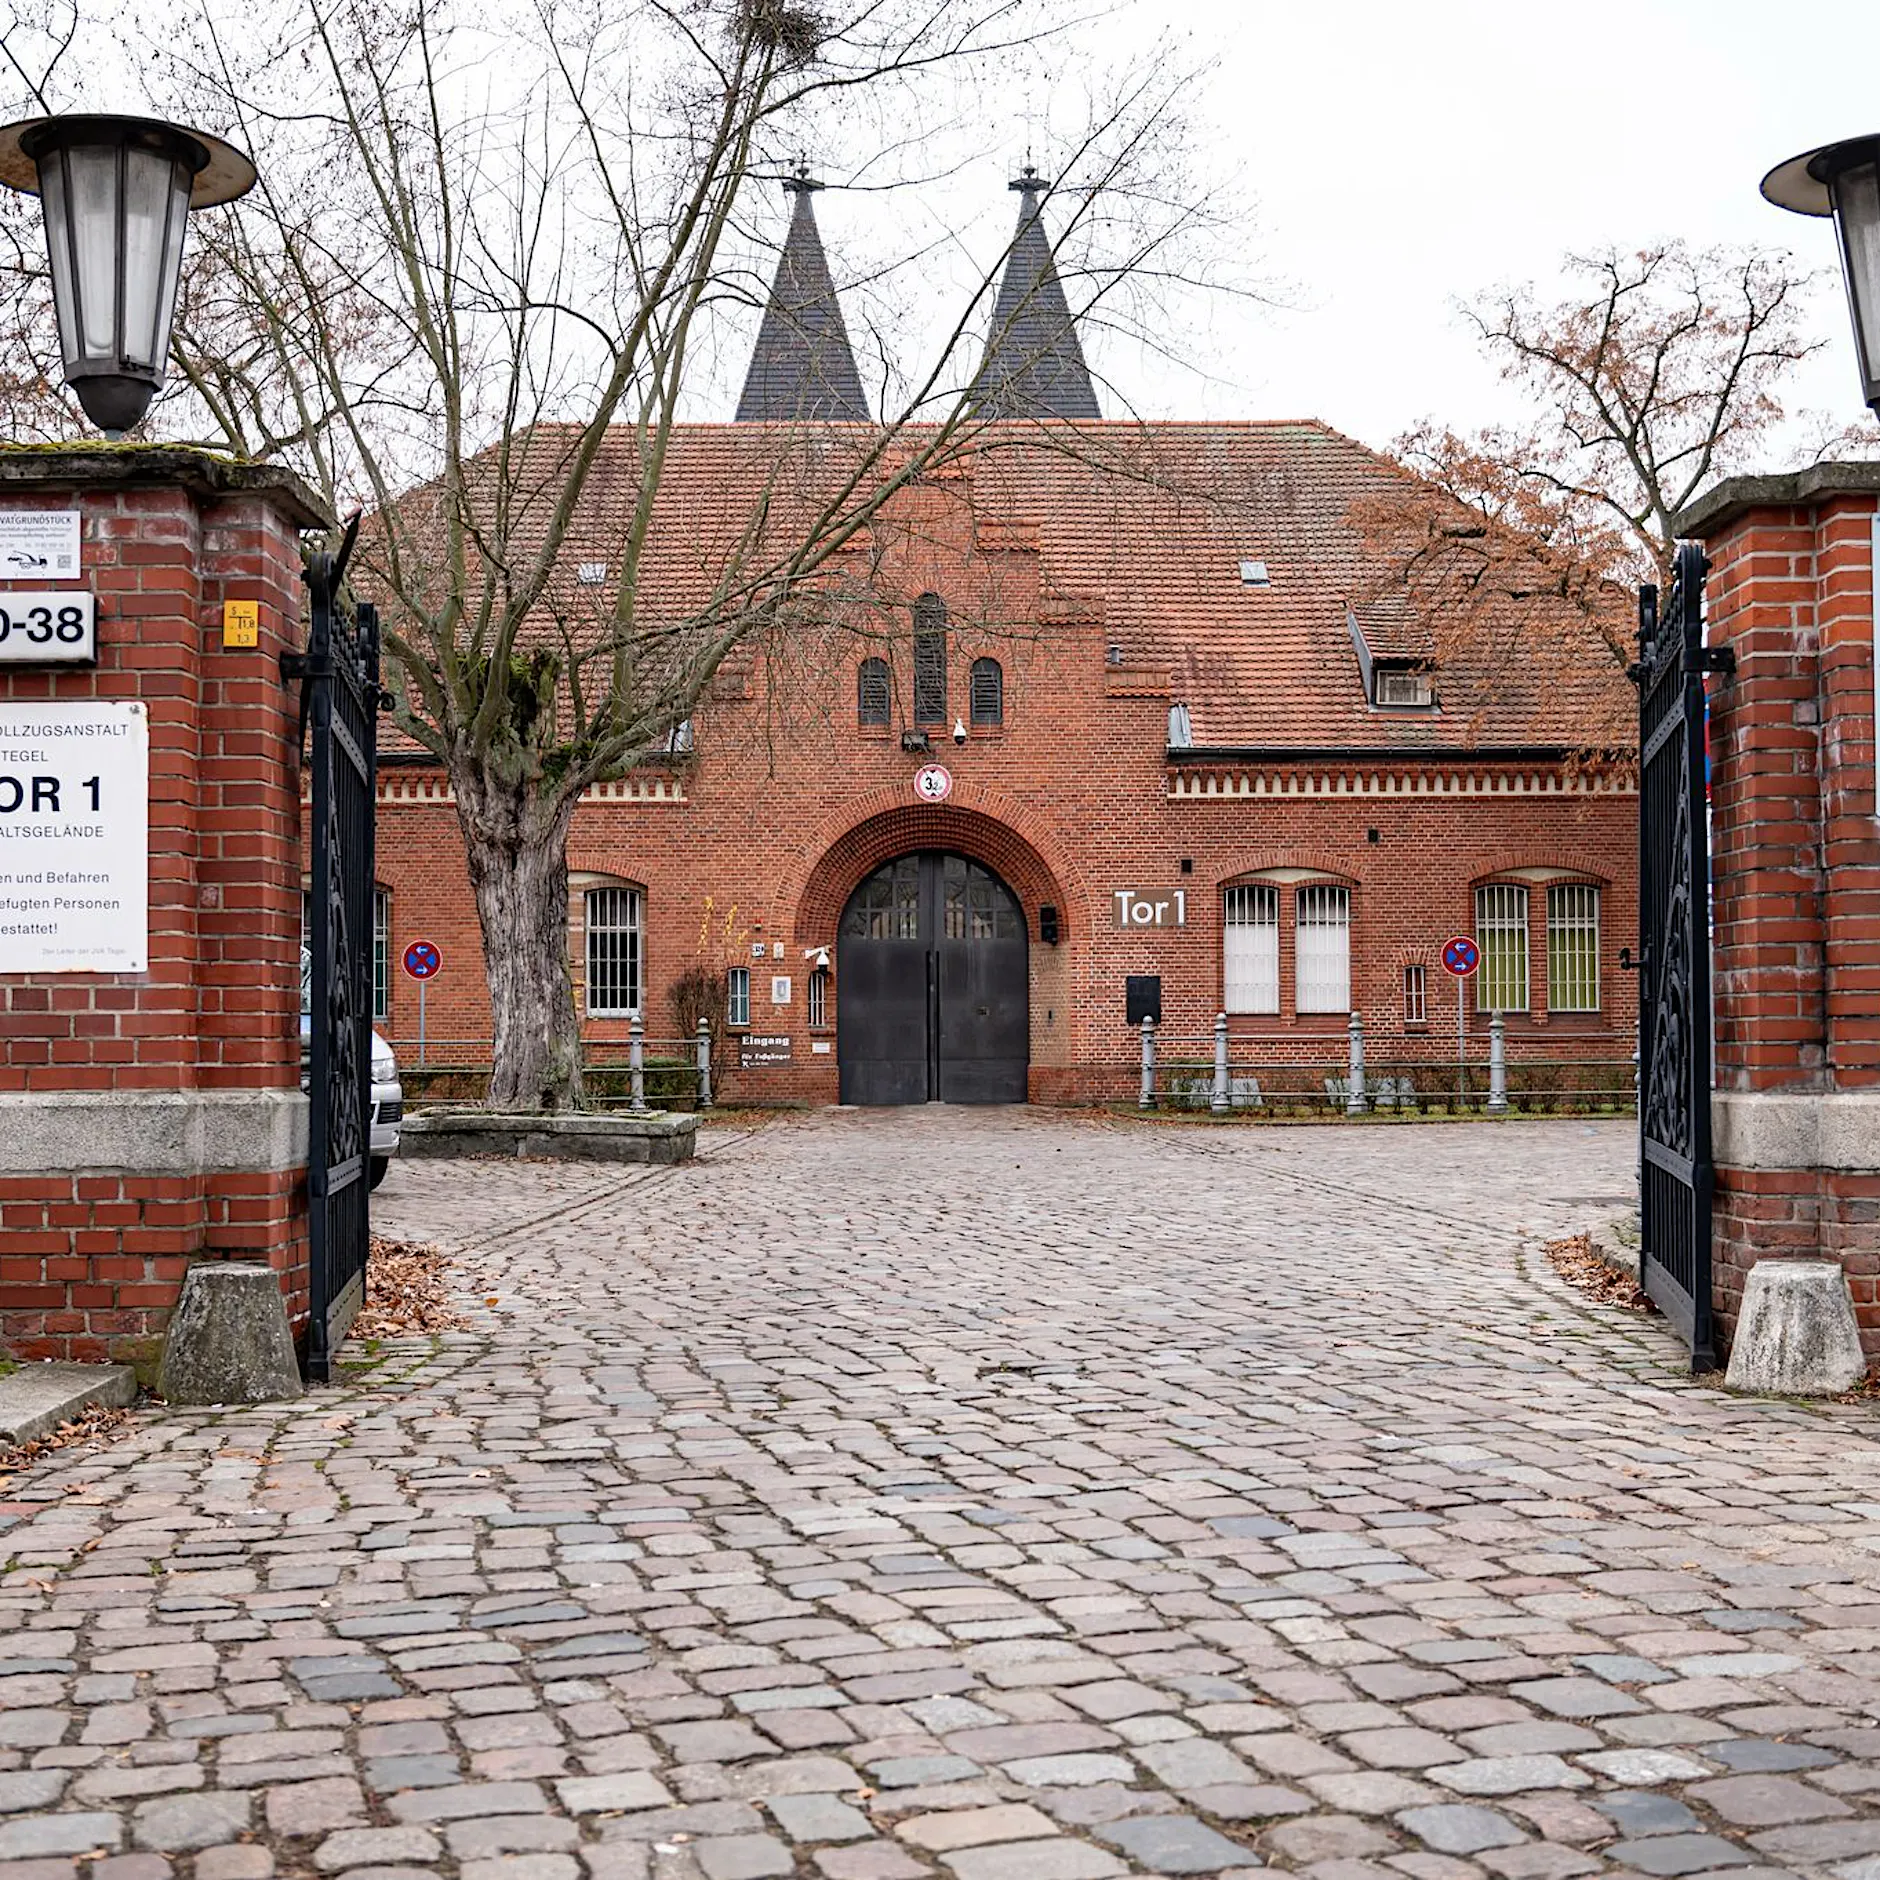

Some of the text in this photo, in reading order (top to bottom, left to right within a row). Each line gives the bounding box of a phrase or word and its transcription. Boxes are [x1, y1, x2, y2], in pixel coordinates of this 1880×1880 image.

[0, 724, 129, 737] LLZUGSANSTALT
[1, 750, 49, 762] TEGEL
[0, 776, 100, 813] OR 1
[16, 872, 42, 883] und
[46, 871, 110, 883] Befahren
[0, 897, 120, 912] efugten Personen
[1115, 891, 1185, 925] Tor 1
[1, 923, 58, 935] estattet!
[742, 1036, 789, 1046] Eingang
